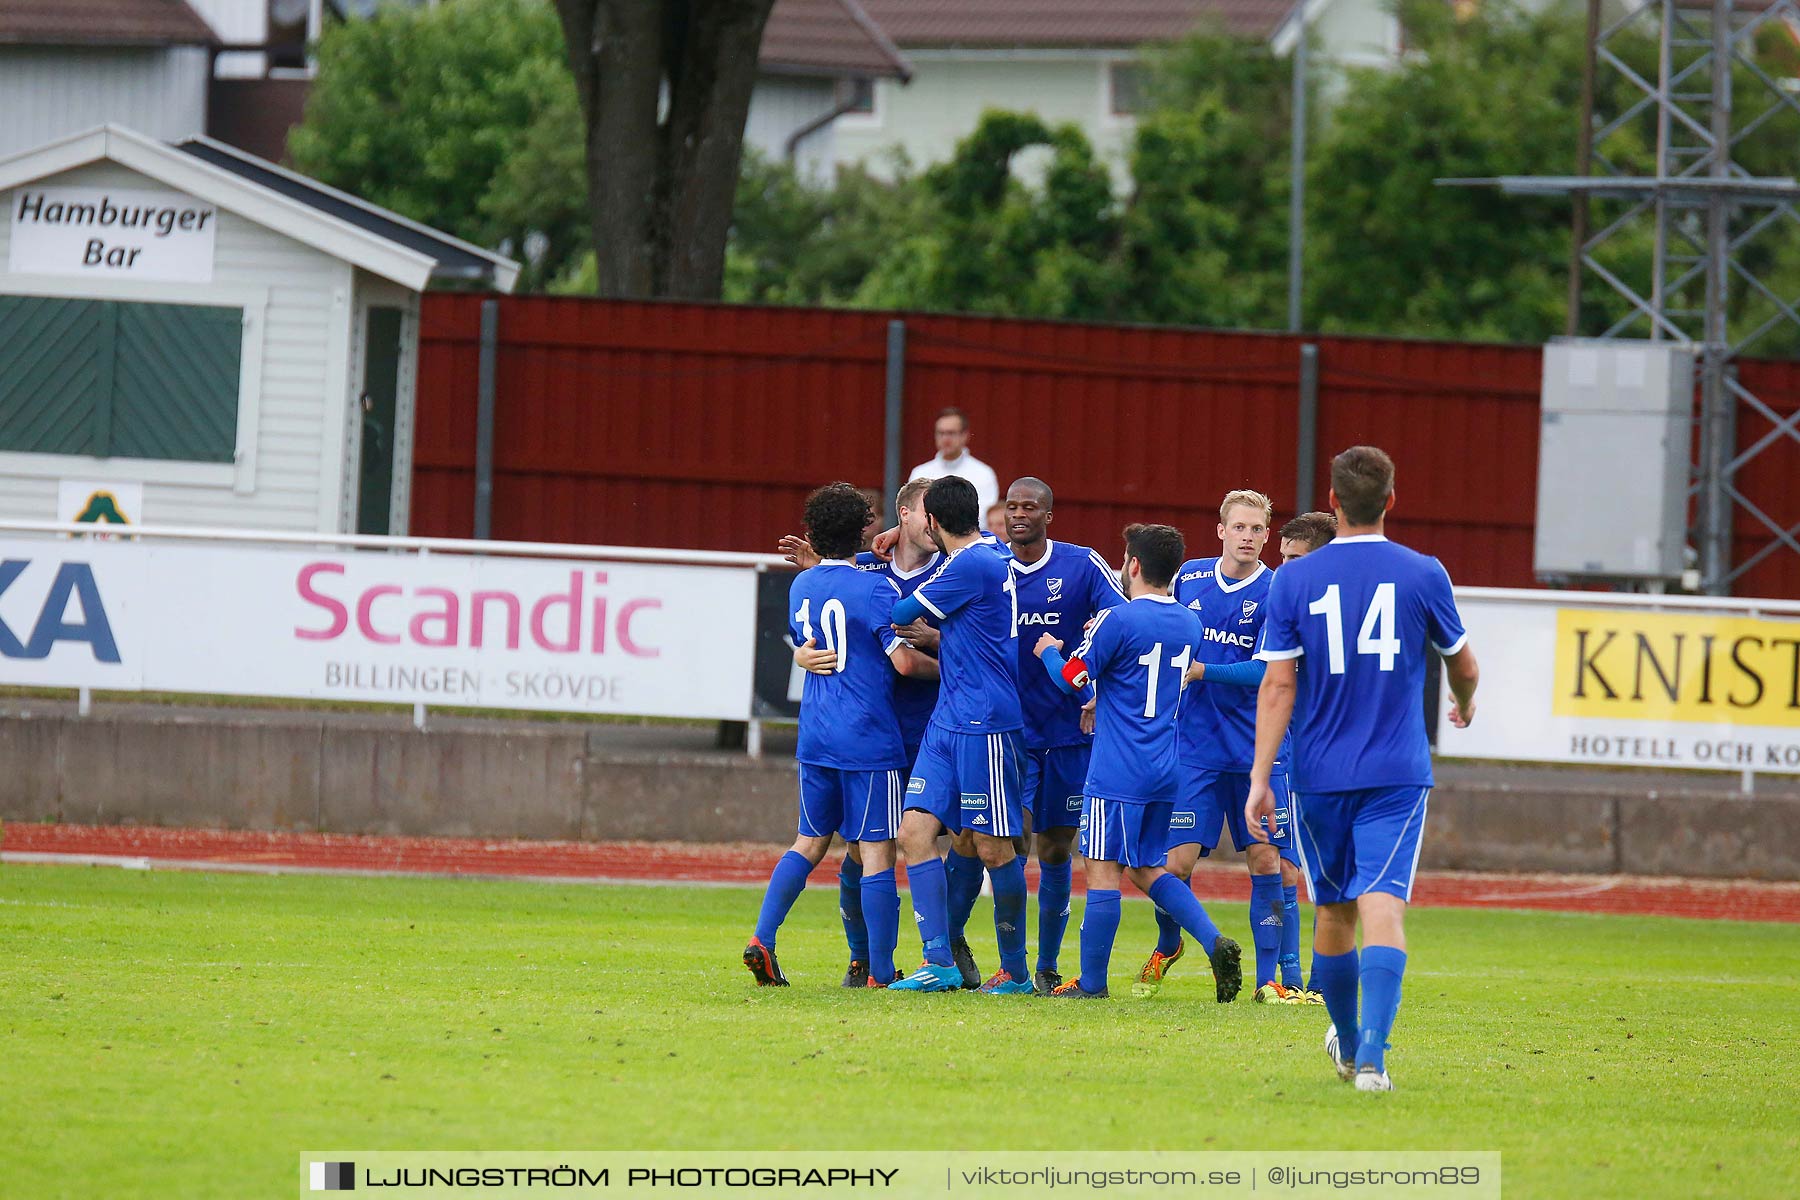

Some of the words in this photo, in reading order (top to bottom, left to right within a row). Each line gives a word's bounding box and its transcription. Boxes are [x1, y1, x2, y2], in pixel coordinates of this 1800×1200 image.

[18, 192, 212, 237] Hamburger
[82, 238, 142, 269] Bar
[295, 562, 662, 657] Scandic
[795, 599, 847, 673] 10
[1309, 583, 1401, 674] 14
[325, 662, 481, 694] BILLINGEN
[505, 666, 624, 701] SKÖVDE
[1138, 642, 1191, 719] 11
[1571, 629, 1800, 709] KNIST
[1571, 735, 1679, 760] HOTELL
[1694, 740, 1753, 763] OCH
[1765, 744, 1800, 766] KO
[961, 797, 985, 805] urhoffs
